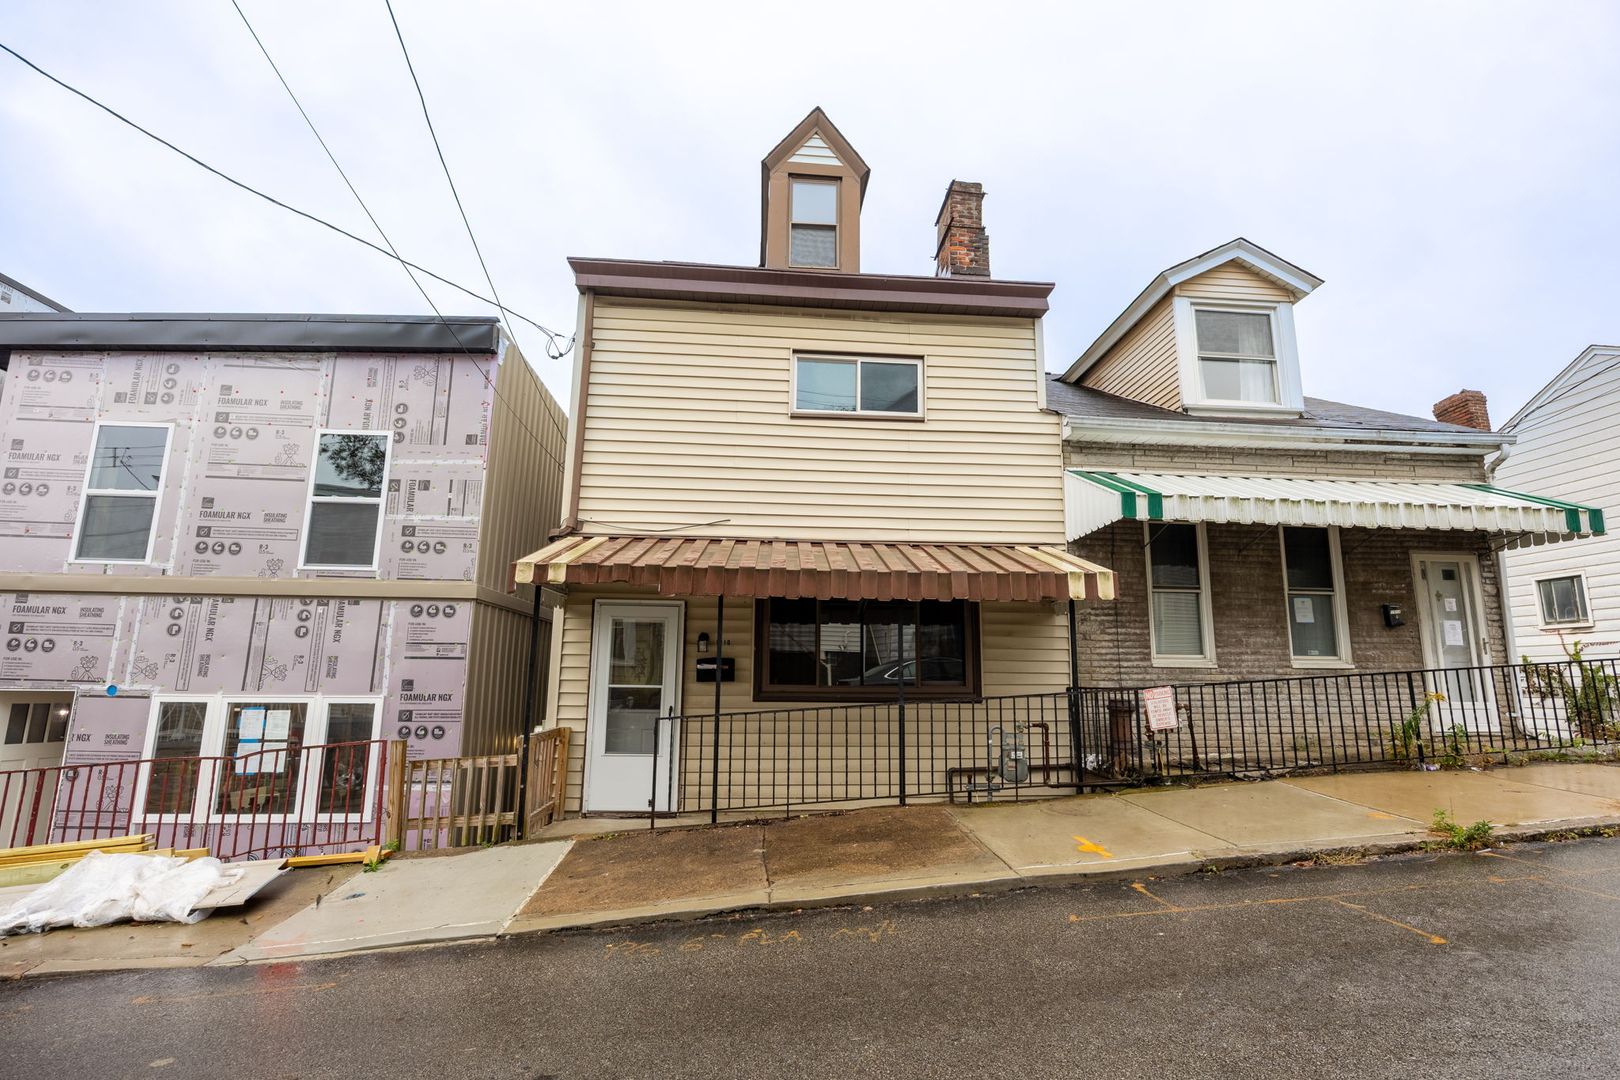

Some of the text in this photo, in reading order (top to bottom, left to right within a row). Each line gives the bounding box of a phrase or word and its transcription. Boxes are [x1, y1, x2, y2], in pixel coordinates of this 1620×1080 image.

[128, 372, 140, 404] FOAMULAR
[218, 397, 252, 406] FOAMULAR
[8, 452, 46, 460] FOAMULAR
[406, 480, 416, 512] FOAMULAR
[199, 510, 236, 519] FOAMULAR
[12, 605, 50, 614] FOAMULAR
[205, 598, 219, 642] AMULAR NGX
[333, 600, 345, 643] AMULAR NGX
[400, 693, 454, 702] FOAMULAR NGX
[76, 734, 92, 742] NGX
